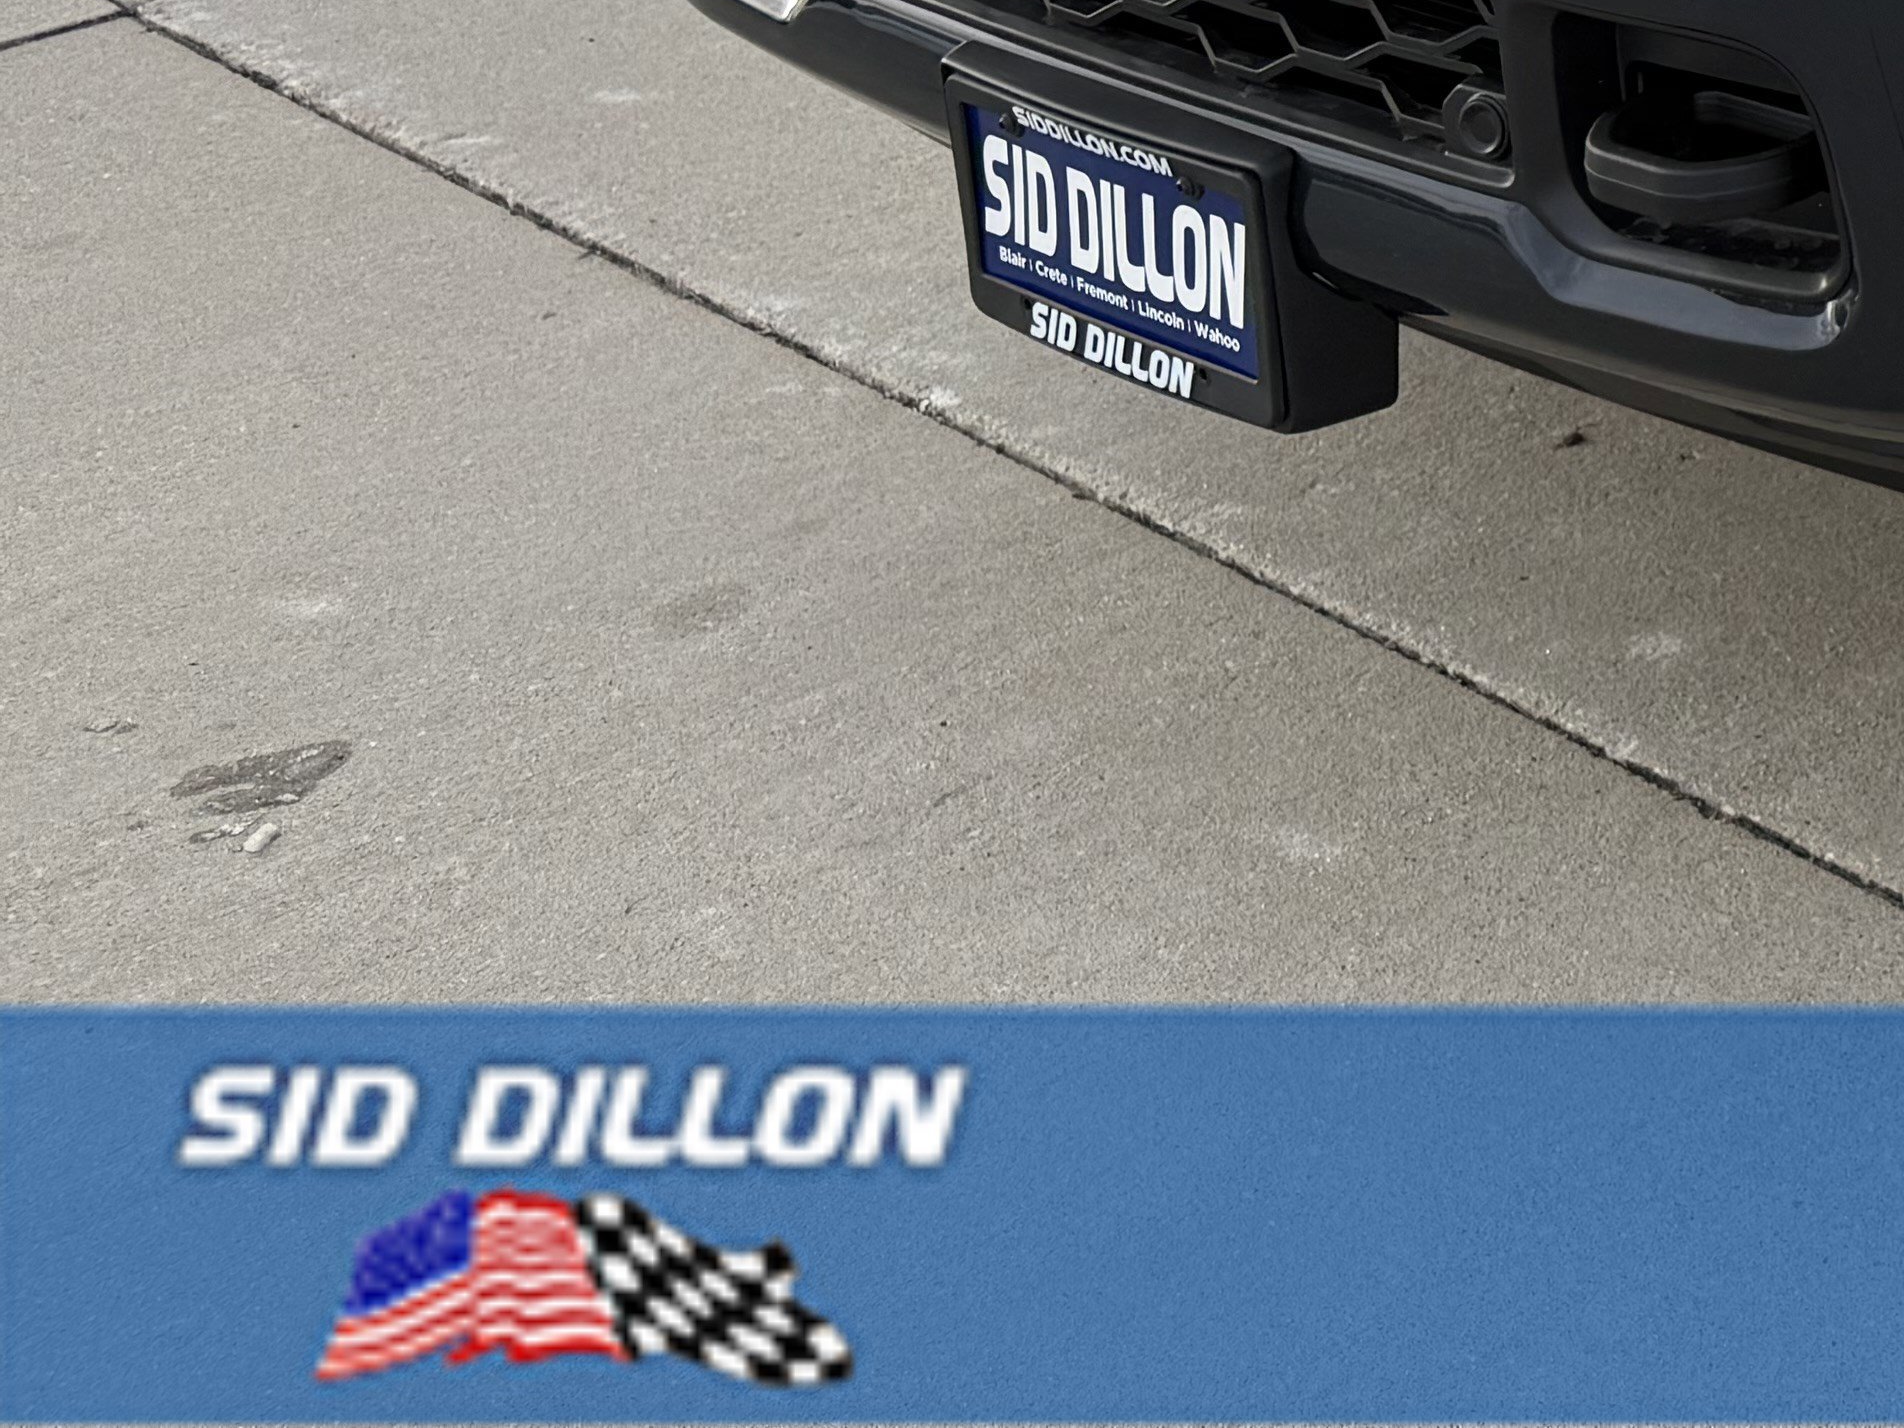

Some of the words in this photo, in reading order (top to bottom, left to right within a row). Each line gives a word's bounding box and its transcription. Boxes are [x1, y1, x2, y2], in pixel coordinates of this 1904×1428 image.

[1012, 106, 1173, 177] SIDDILLON.COM
[983, 134, 1058, 256] SID
[1066, 167, 1246, 329] DILLON
[999, 246, 1027, 270] Blair
[1035, 261, 1068, 287] Crete
[1077, 276, 1128, 310] Fremont
[1138, 300, 1185, 331] Lincoln
[1195, 319, 1241, 352] Wahoo
[1030, 301, 1076, 352] SID
[1084, 326, 1195, 399] DILLON
